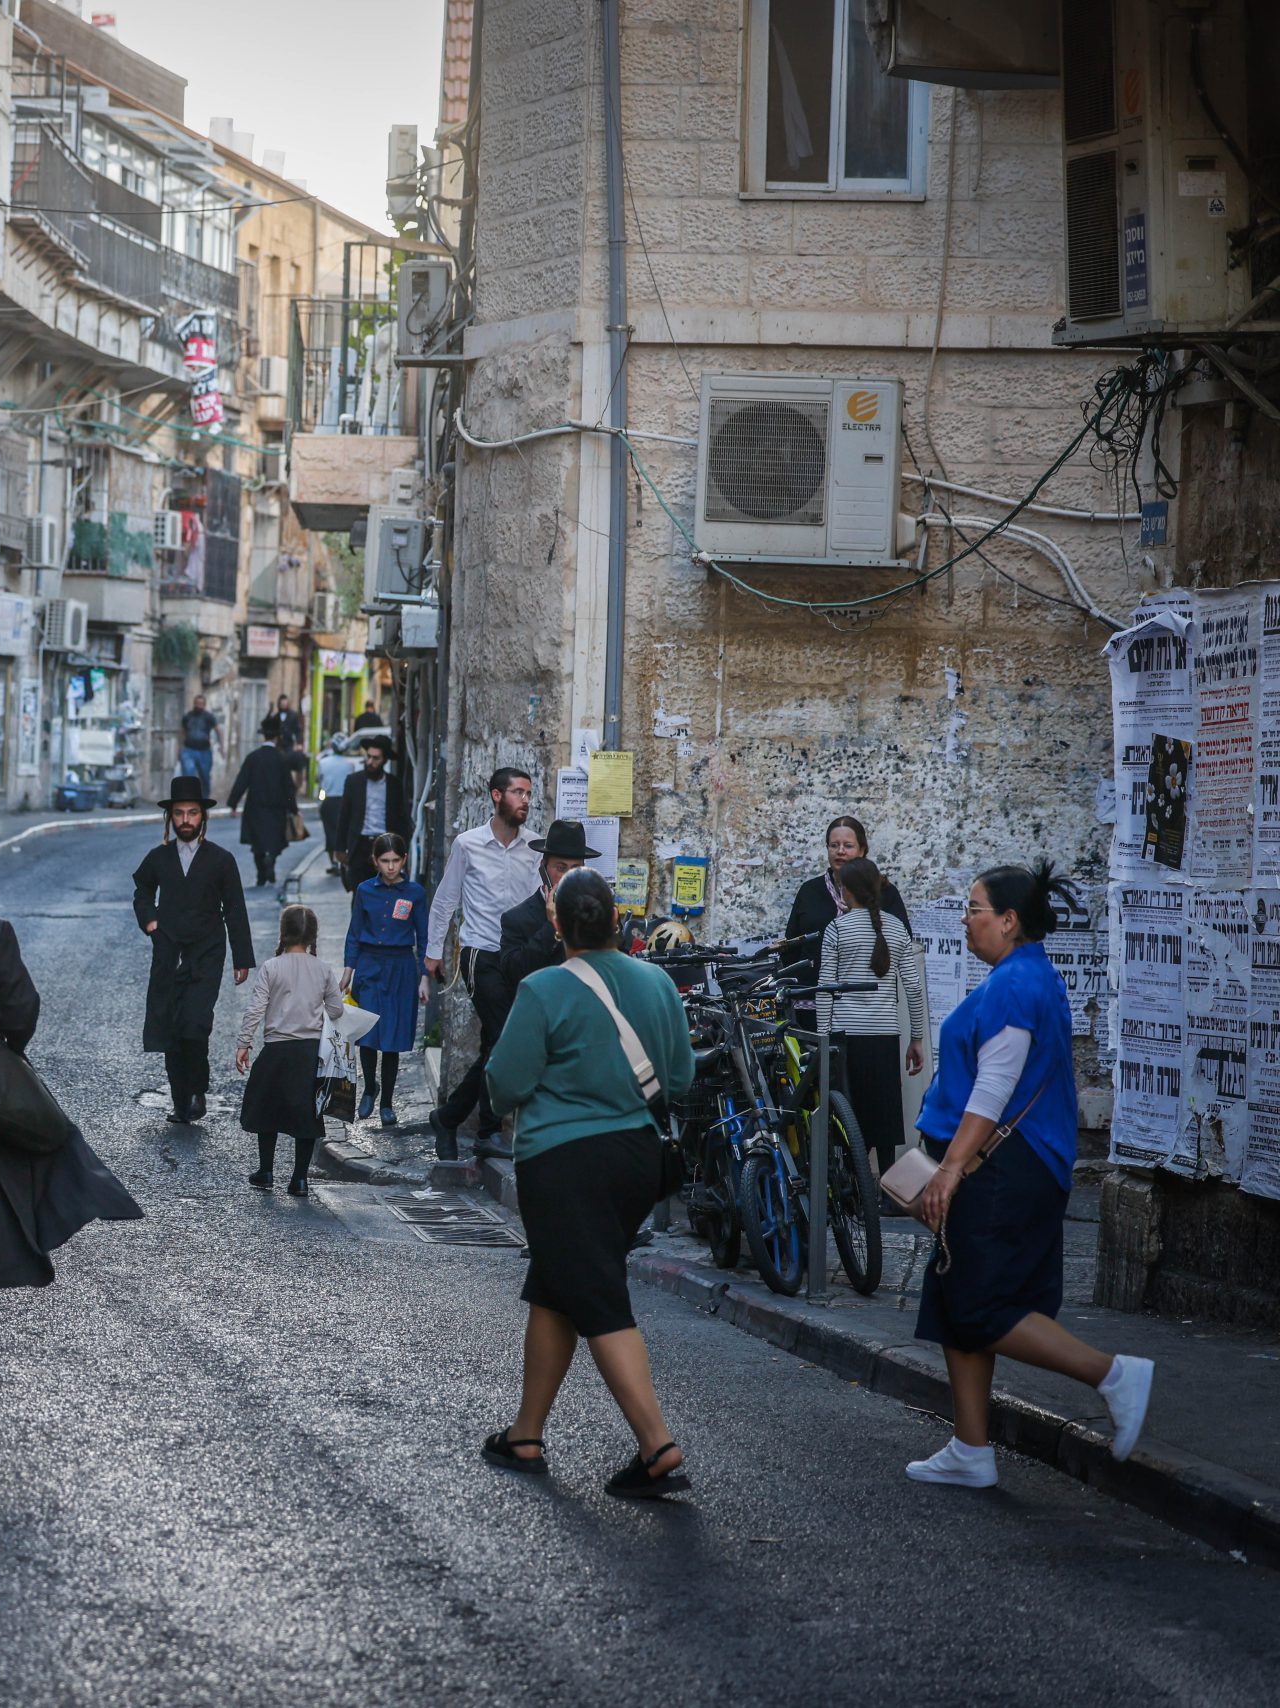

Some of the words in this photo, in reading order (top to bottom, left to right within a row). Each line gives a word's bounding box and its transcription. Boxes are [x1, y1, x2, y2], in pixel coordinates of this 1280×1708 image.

[841, 423, 881, 431] ELECTRA
[1142, 517, 1149, 531] 53
[1200, 705, 1225, 722] קדושה
[1227, 702, 1250, 718] קריאה
[1122, 889, 1148, 905] האמת
[1163, 891, 1182, 908] ברוך
[938, 938, 962, 955] פייגא
[1161, 934, 1182, 964] שרה
[1121, 1018, 1144, 1035] האמת
[1187, 1011, 1195, 1028] של
[1229, 1019, 1238, 1032] כבר
[1159, 1023, 1182, 1040] ברוך
[1157, 1066, 1180, 1098] שרה
